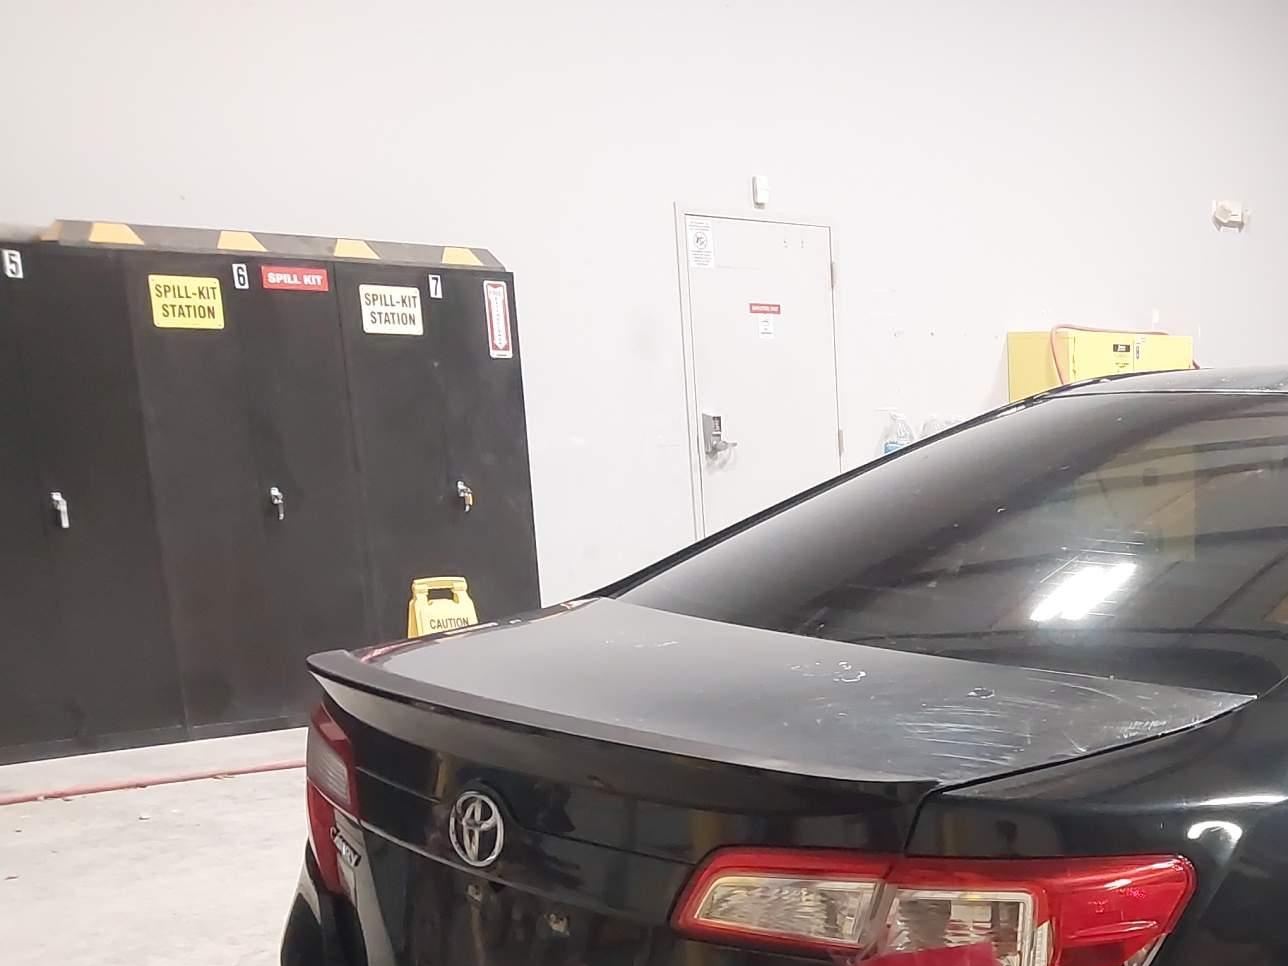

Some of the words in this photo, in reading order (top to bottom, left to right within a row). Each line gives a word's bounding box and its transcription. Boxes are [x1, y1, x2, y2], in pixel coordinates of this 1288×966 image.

[9, 253, 20, 275] 5
[236, 266, 246, 286] 6
[267, 272, 301, 285] SPILL
[303, 274, 323, 286] KIT
[155, 284, 217, 300] SPILL-KIT
[431, 277, 439, 296] 7
[364, 293, 418, 309] SPILL-KIT
[161, 304, 216, 319] STATION
[370, 312, 416, 326] STATION
[429, 617, 469, 629] CAUTION
